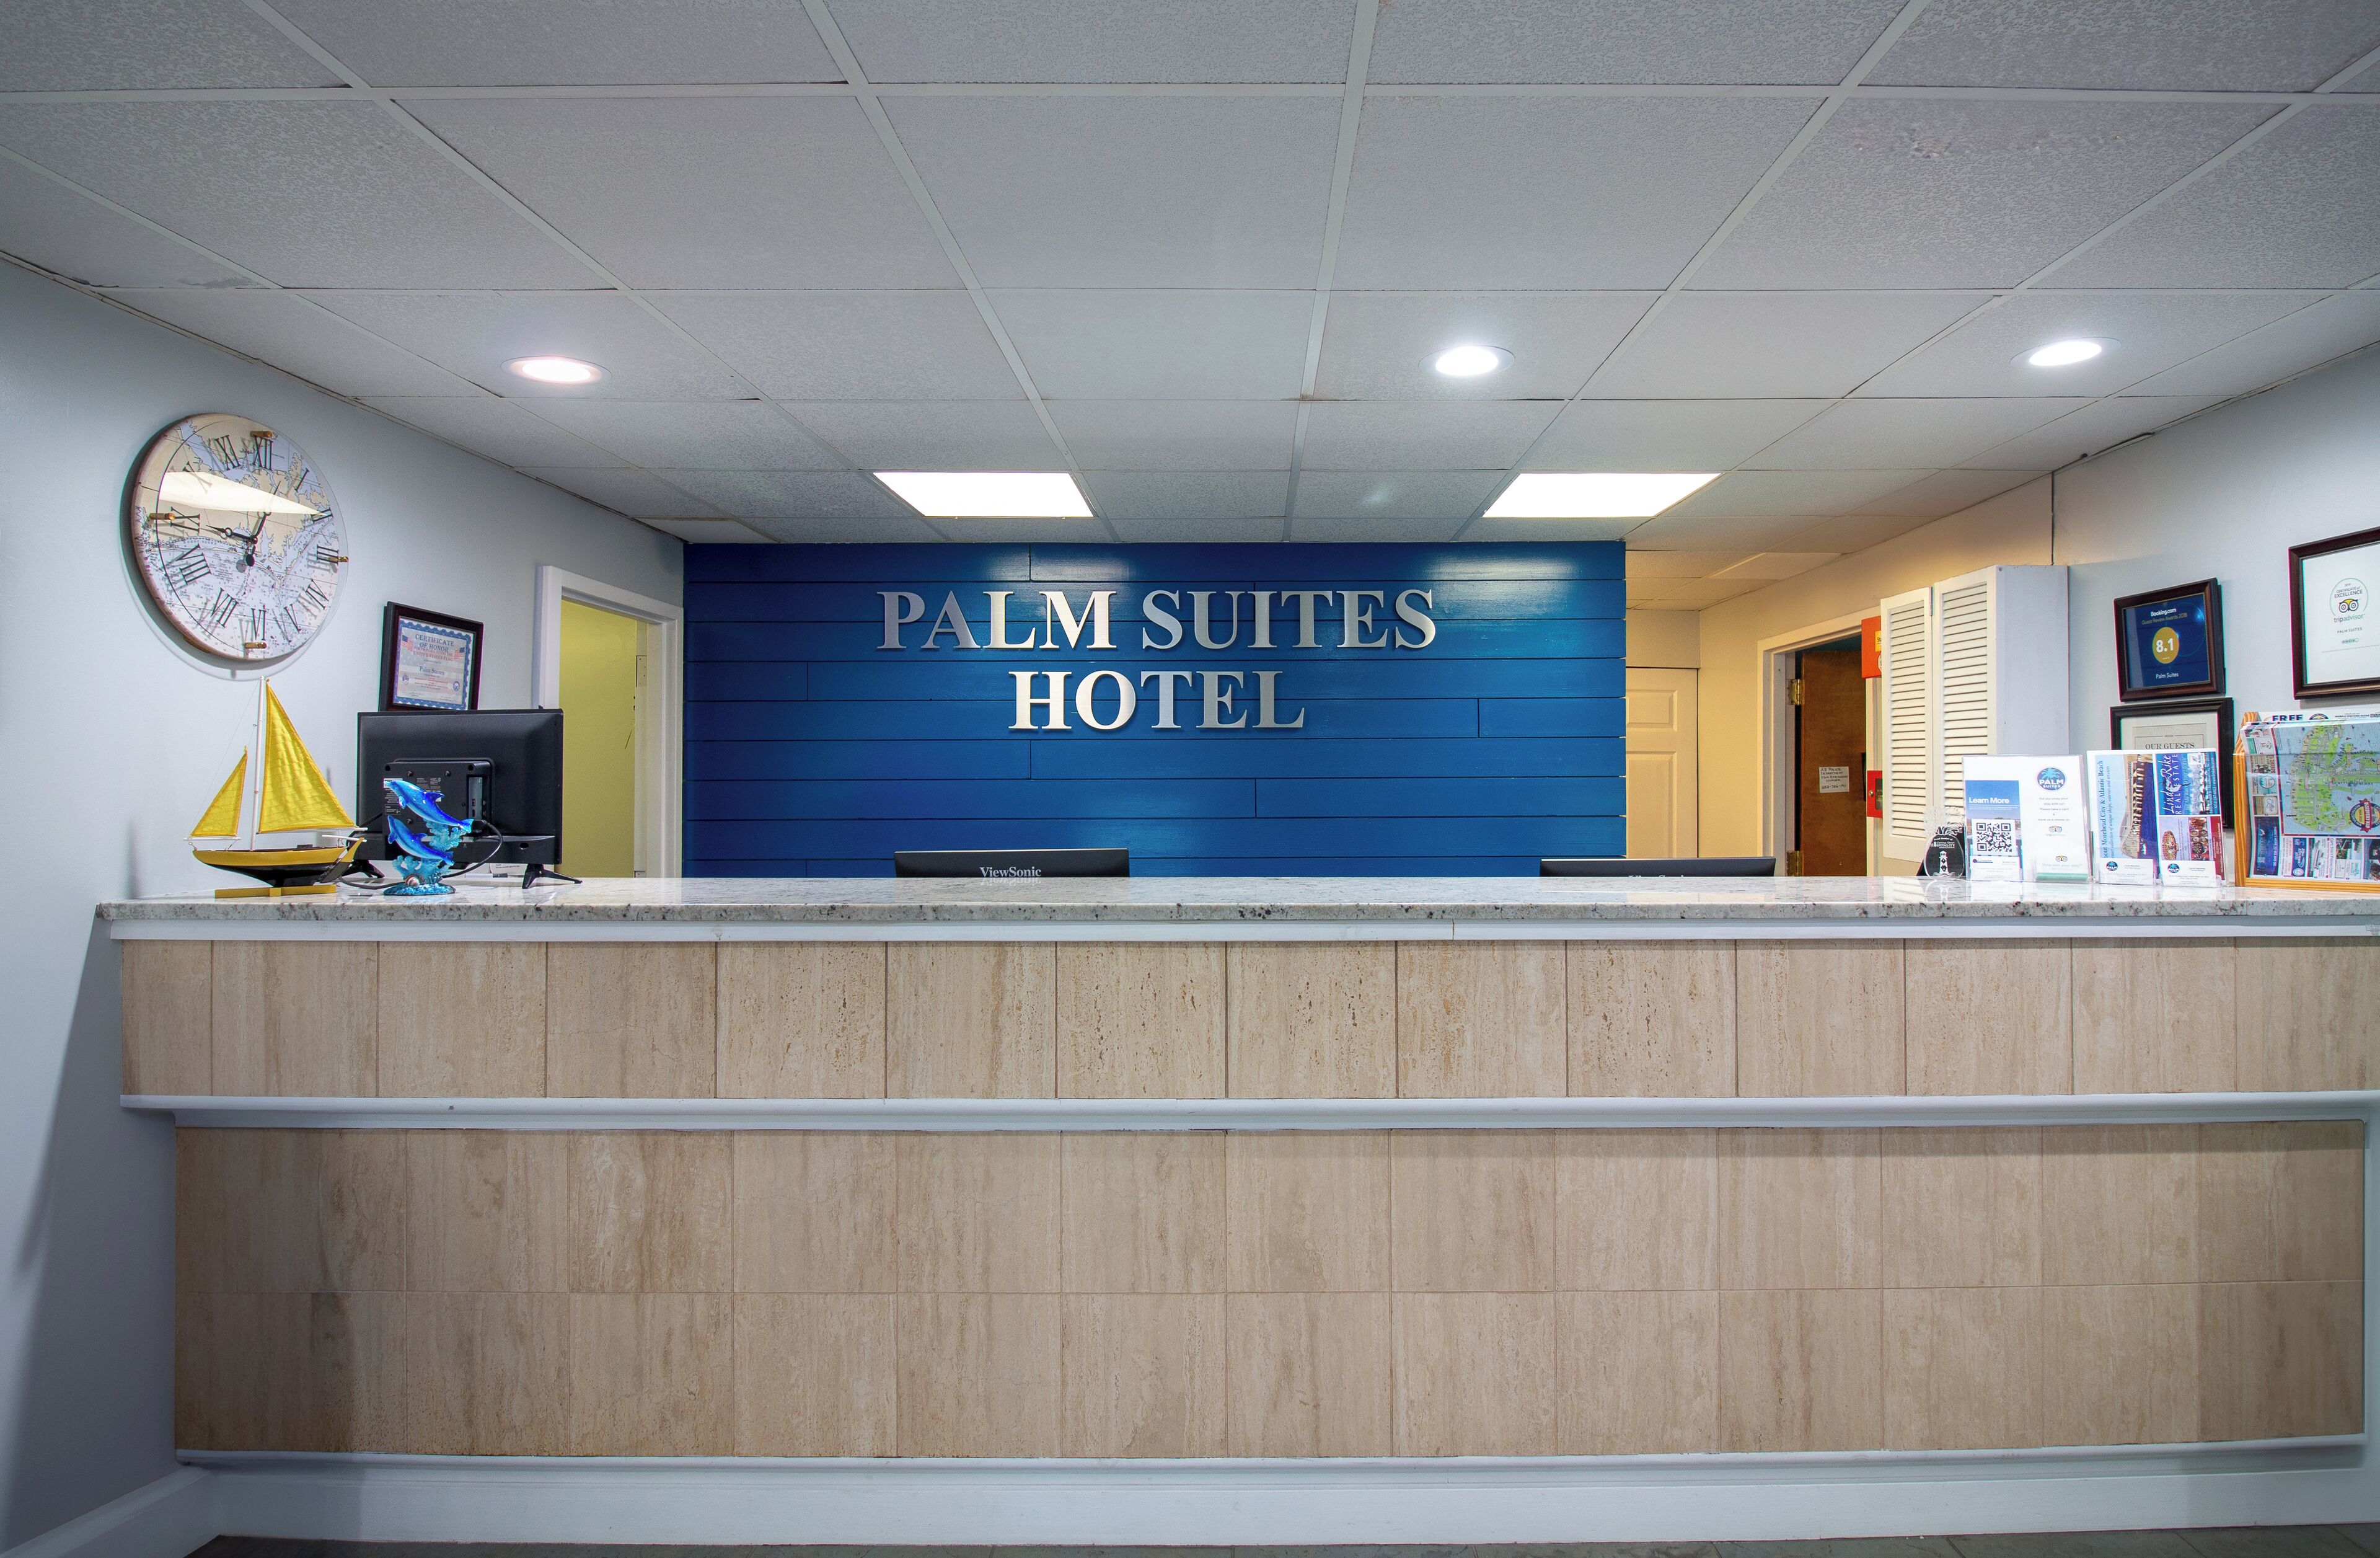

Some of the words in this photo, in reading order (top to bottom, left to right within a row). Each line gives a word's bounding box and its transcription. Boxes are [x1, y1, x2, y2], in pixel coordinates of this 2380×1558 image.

[2334, 589, 2363, 598] EXCELLENCE
[876, 590, 1117, 649] PALM
[1142, 588, 1437, 650] SUITES
[2150, 608, 2177, 617] Booking.com
[2334, 614, 2364, 623] tripadvisor
[415, 634, 454, 647] CERTIFICATE
[2156, 637, 2174, 653] 8.1
[429, 644, 449, 653] HONOR
[419, 666, 431, 674] Palm
[1008, 670, 1305, 730] HOTEL
[2157, 755, 2172, 779] Rike
[2171, 754, 2180, 786] ESTATE
[2159, 786, 2175, 814] Linda
[2174, 793, 2182, 815] REAL
[2099, 807, 2107, 817] City
[2100, 818, 2108, 846] Morehead
[979, 865, 1042, 878] ViewSonic
